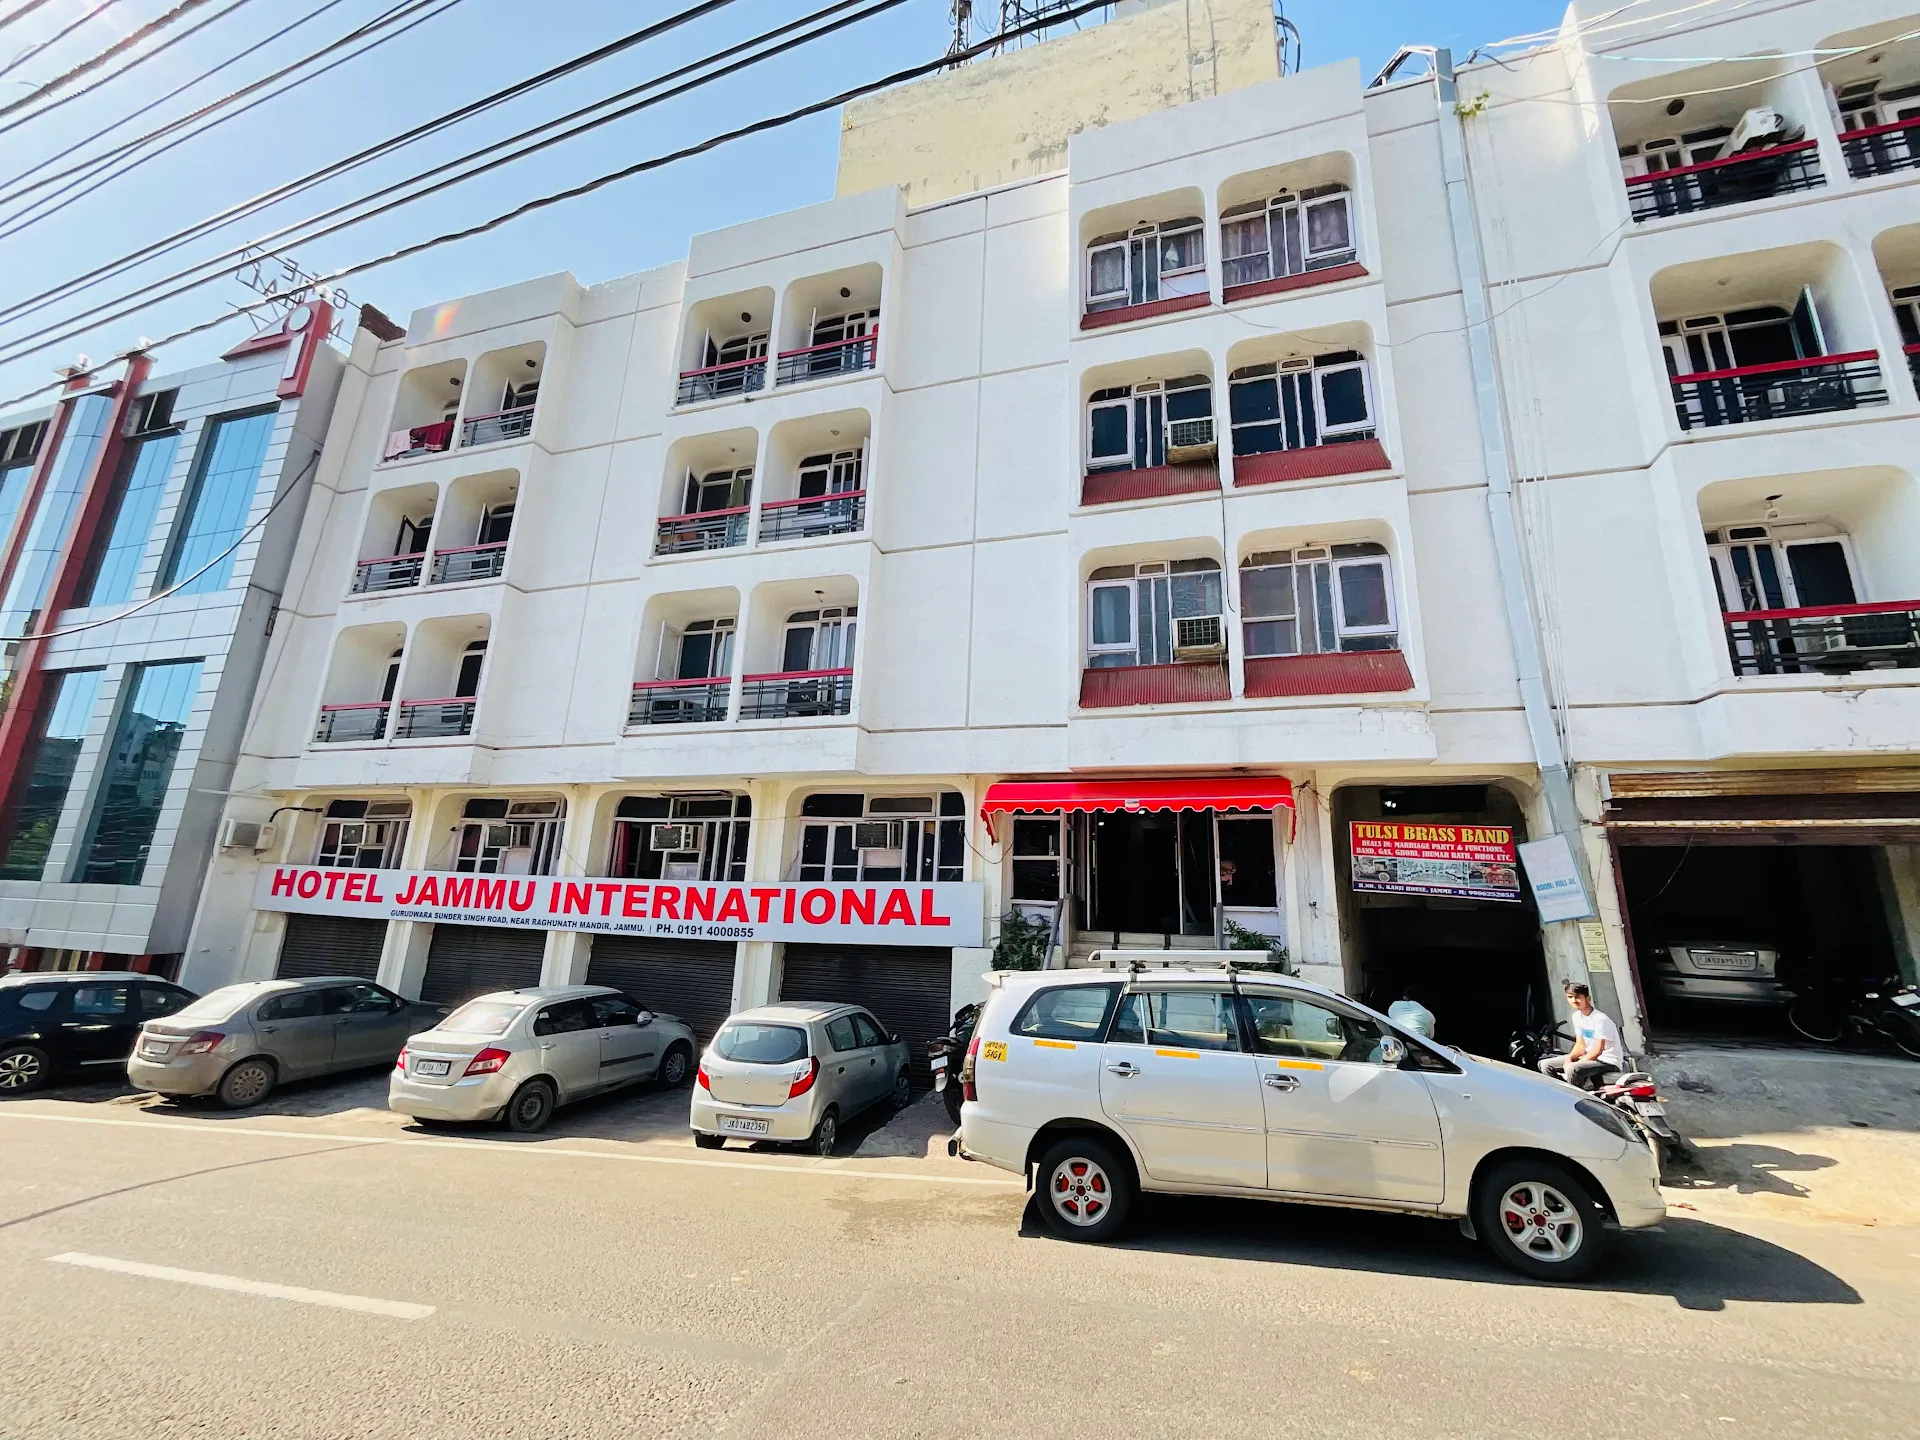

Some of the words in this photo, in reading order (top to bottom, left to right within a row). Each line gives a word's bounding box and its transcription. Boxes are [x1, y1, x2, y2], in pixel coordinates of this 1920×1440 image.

[1356, 824, 1398, 839] TULSI
[1403, 826, 1456, 842] BRASS
[1461, 828, 1509, 844] BAND
[1394, 841, 1430, 849] MARRIAGE
[1431, 843, 1455, 851] PARTY
[271, 868, 384, 903] HOTEL
[395, 875, 537, 912] JAMMU
[549, 881, 952, 927] INTERNATIONAL
[390, 909, 433, 919] GURUDWARA
[434, 912, 462, 921] SUNDER
[463, 914, 486, 922] SINGH
[487, 916, 509, 925] ROAD,
[510, 917, 530, 925] NEAR
[532, 918, 577, 928] RAGHUNATH
[579, 921, 612, 931] MANDIR,
[613, 923, 645, 932] JAMMU.
[656, 923, 674, 934] PH.
[677, 924, 703, 935] 0191
[706, 925, 754, 938] 4000855
[727, 1120, 766, 1132] JK01AB2356
